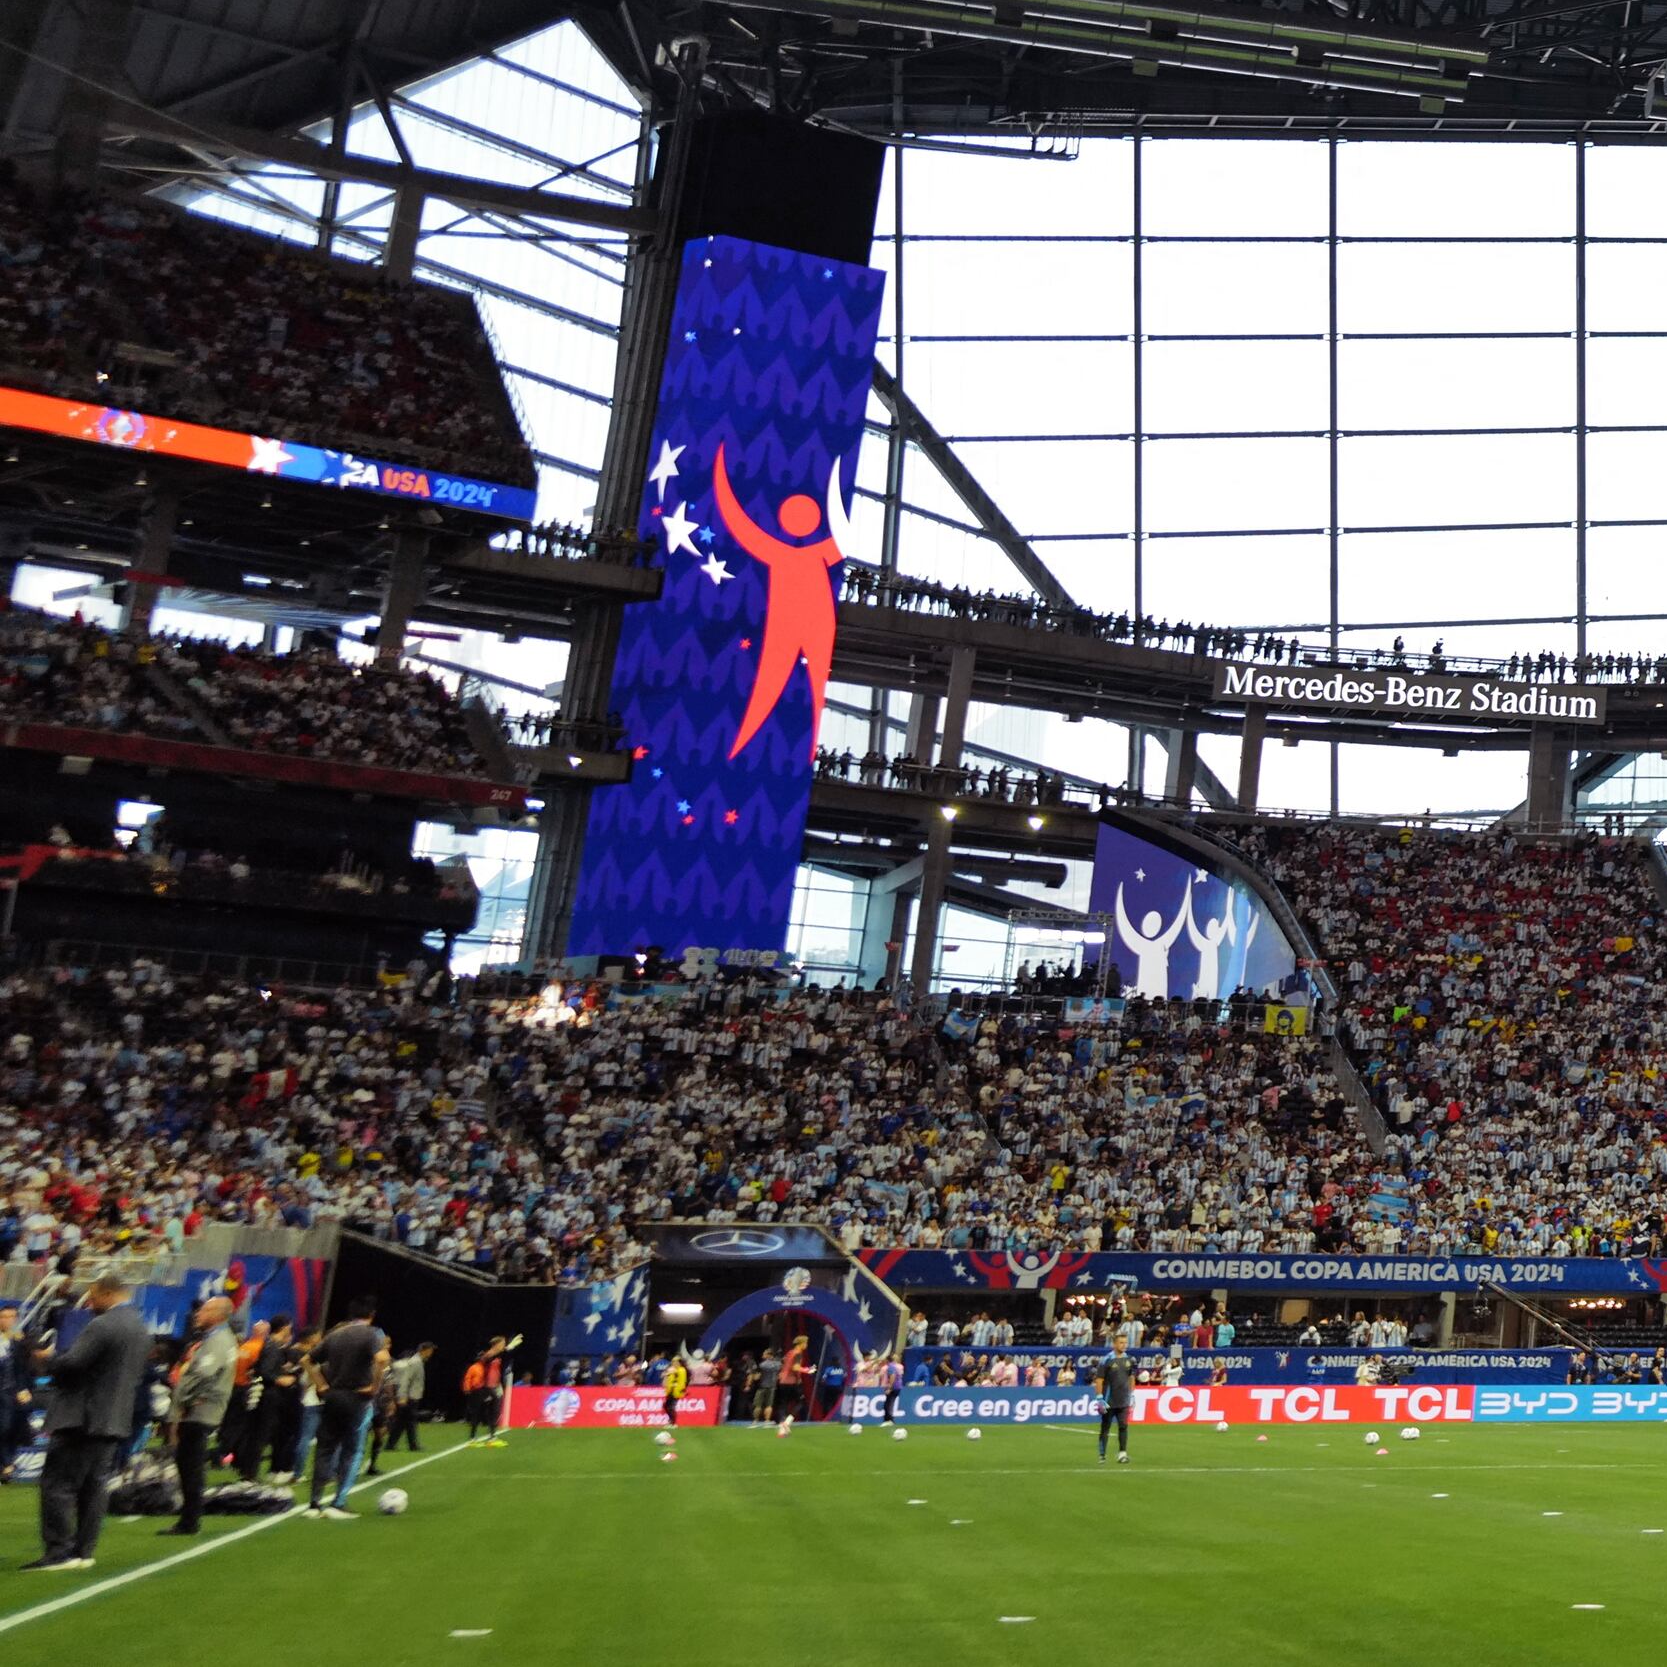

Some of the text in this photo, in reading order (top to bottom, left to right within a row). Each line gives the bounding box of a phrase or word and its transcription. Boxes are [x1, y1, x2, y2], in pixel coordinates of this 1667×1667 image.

[382, 468, 431, 498] USA
[433, 479, 494, 508] 2024
[1221, 665, 1599, 719] Mercedes-Benz Stadium
[1152, 1259, 1564, 1283] CONMEBOL COPA AMERICA USA 2024
[1187, 1356, 1214, 1369] USA
[1424, 1355, 1487, 1369] AMERICA
[1490, 1356, 1518, 1369] USA
[1519, 1356, 1551, 1369] 2024
[592, 1398, 639, 1412] COPA
[914, 1394, 980, 1418] Cree
[982, 1396, 1012, 1418] en
[1013, 1388, 1101, 1423] grande
[1129, 1387, 1224, 1422] TCL
[1249, 1387, 1349, 1422] TCL
[1374, 1387, 1472, 1421] TCL
[1480, 1392, 1579, 1415] BYD
